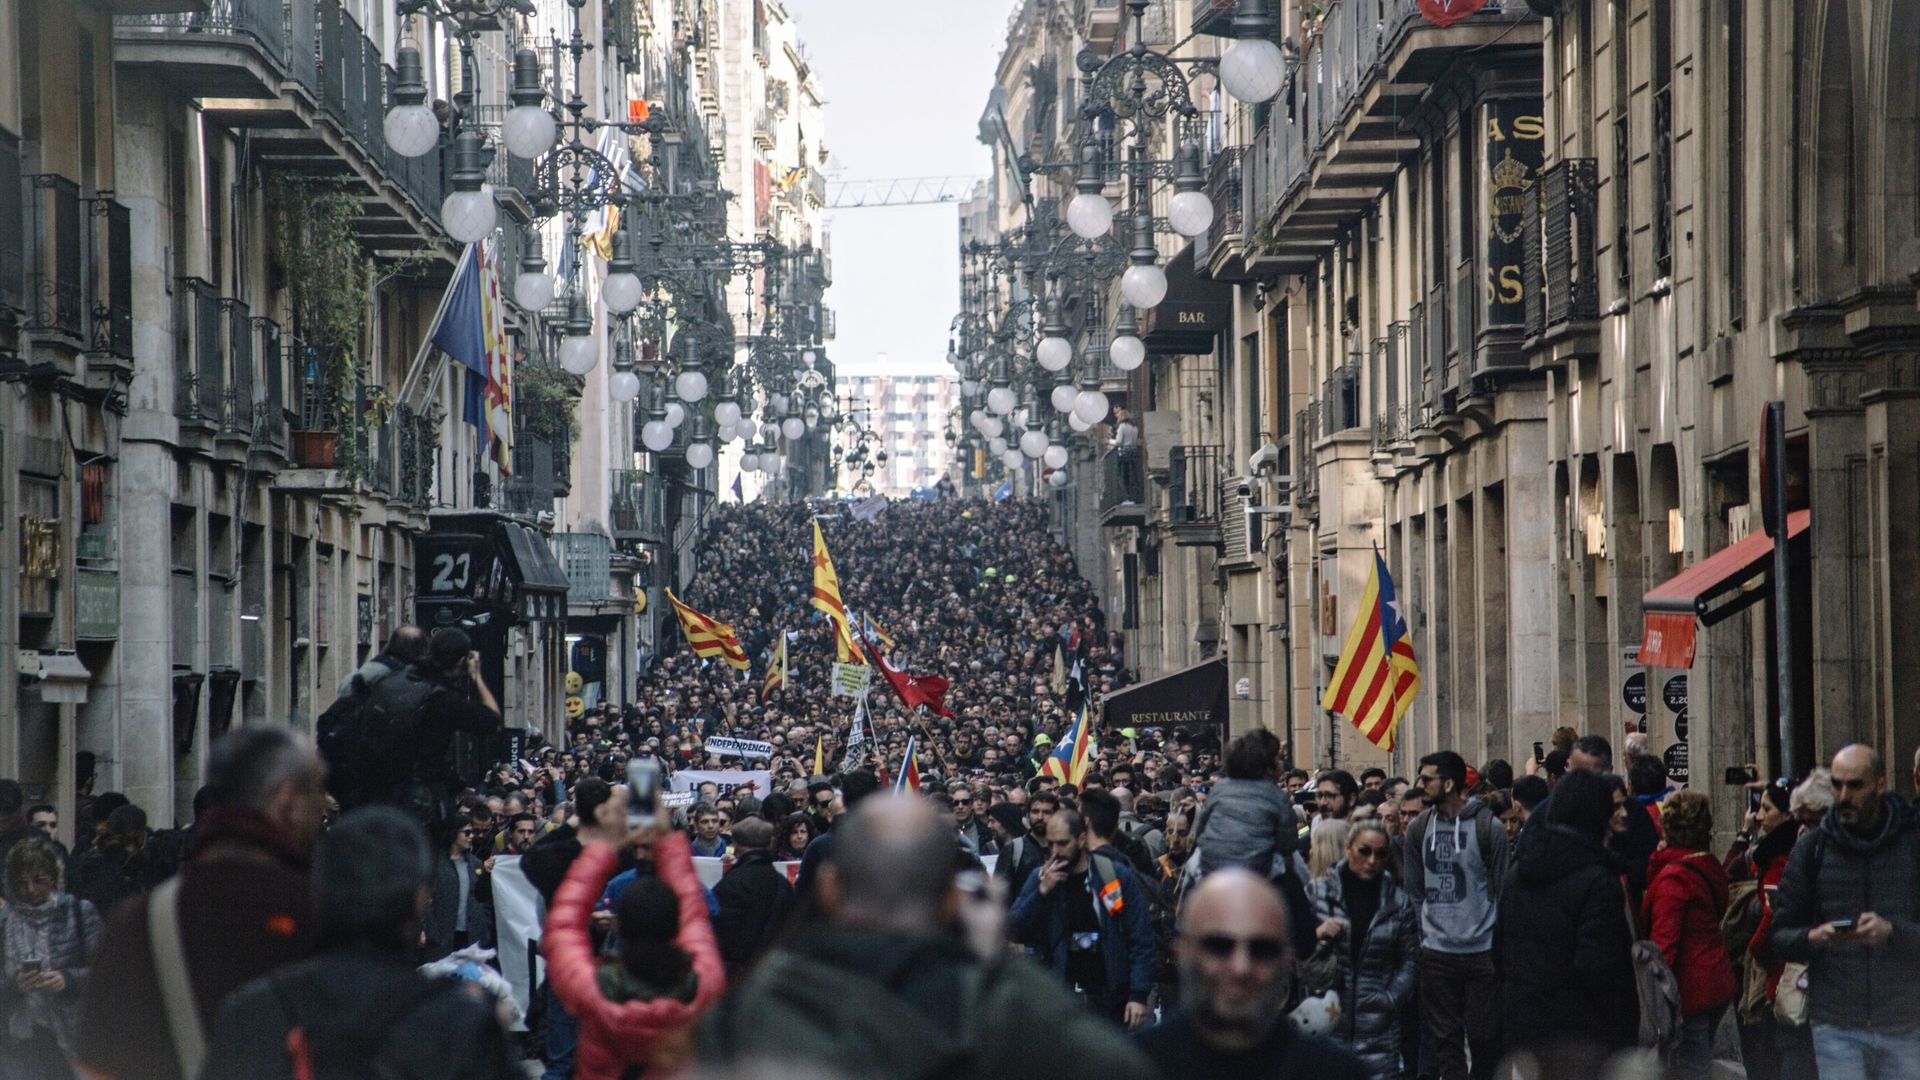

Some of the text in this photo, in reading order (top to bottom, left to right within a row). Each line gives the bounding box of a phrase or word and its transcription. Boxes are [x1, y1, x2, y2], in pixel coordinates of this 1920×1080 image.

[1179, 311, 1206, 323] BAR
[432, 553, 470, 591] 23
[1131, 710, 1213, 724] RESTAURANTE
[1439, 876, 1452, 890] 75
